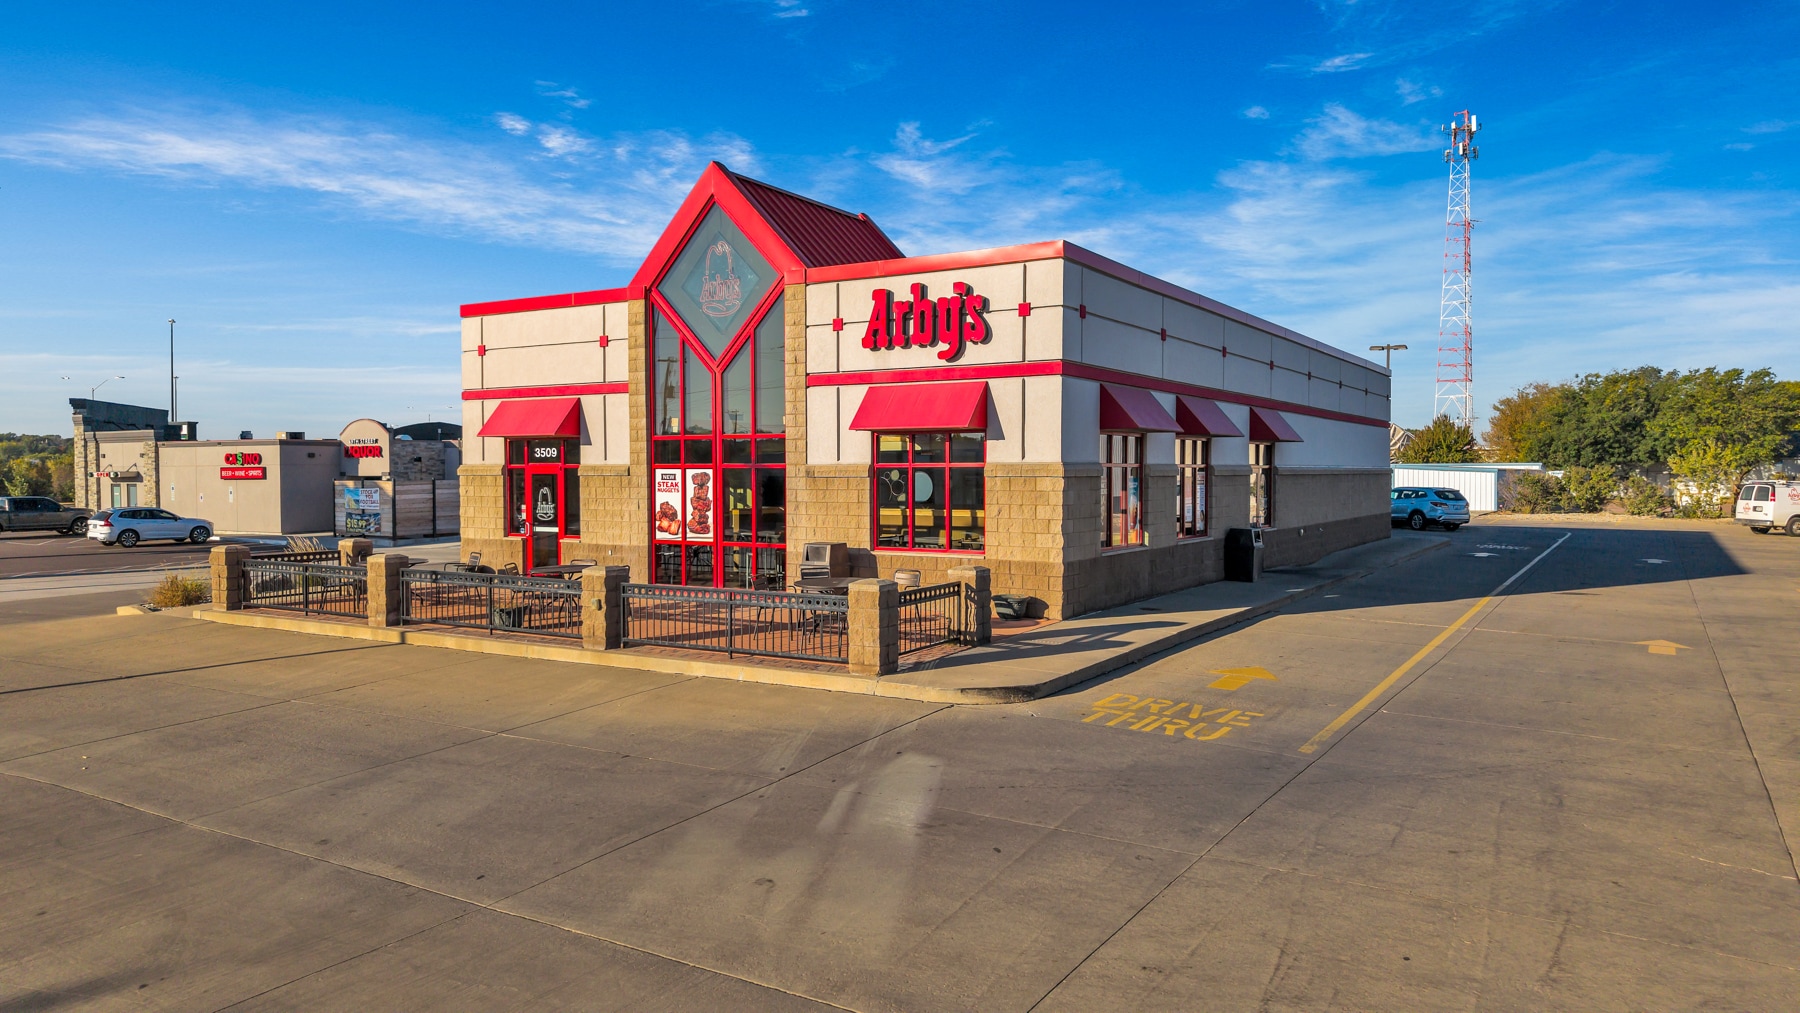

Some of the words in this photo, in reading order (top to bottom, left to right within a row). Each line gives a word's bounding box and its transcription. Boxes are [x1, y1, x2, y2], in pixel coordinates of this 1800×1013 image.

[700, 274, 741, 305] Arby's
[862, 282, 987, 360] Arby's
[344, 445, 381, 458] LIQUOR
[534, 447, 558, 458] 3509
[1081, 707, 1232, 741] THRU
[1092, 693, 1265, 727] DRIVE
